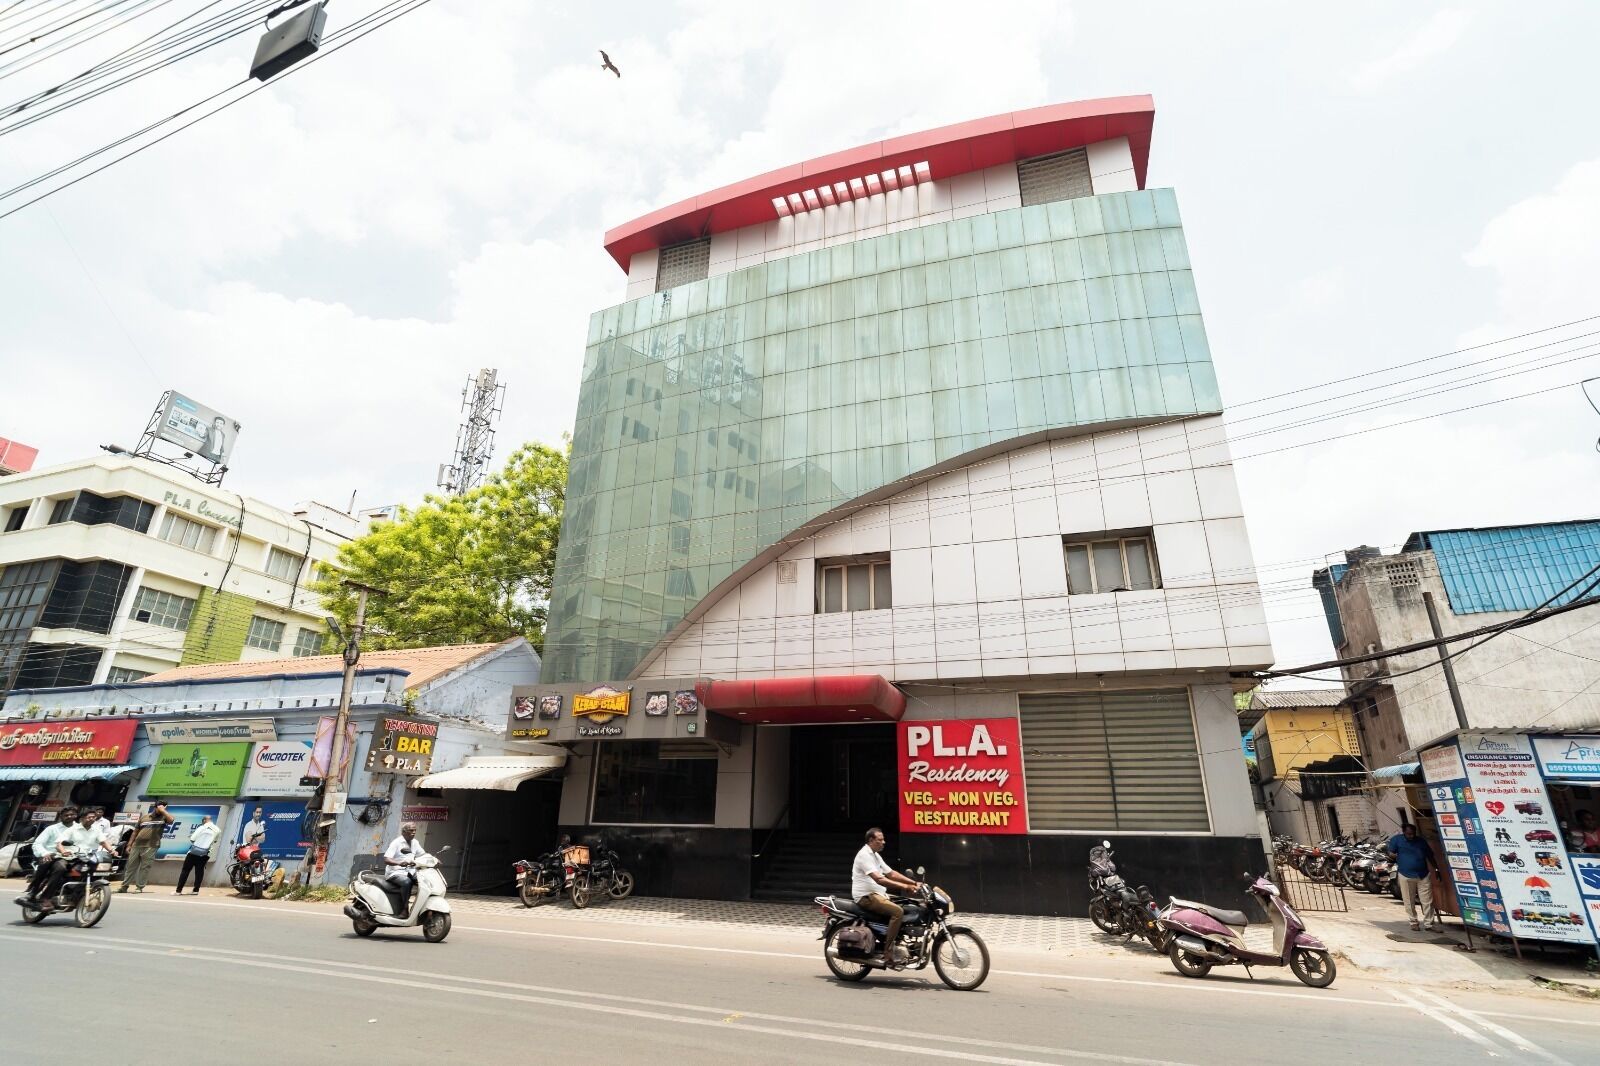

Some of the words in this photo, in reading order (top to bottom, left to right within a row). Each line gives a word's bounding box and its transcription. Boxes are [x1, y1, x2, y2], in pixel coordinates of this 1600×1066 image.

[162, 725, 186, 739] apollo
[397, 736, 431, 754] BAR
[907, 724, 1008, 757] PL.A.
[260, 753, 306, 761] MICROTEK
[908, 761, 1010, 788] Residency
[949, 791, 980, 806] NON
[983, 791, 1018, 806] VEG.
[914, 811, 1010, 826] RESTAURANT
